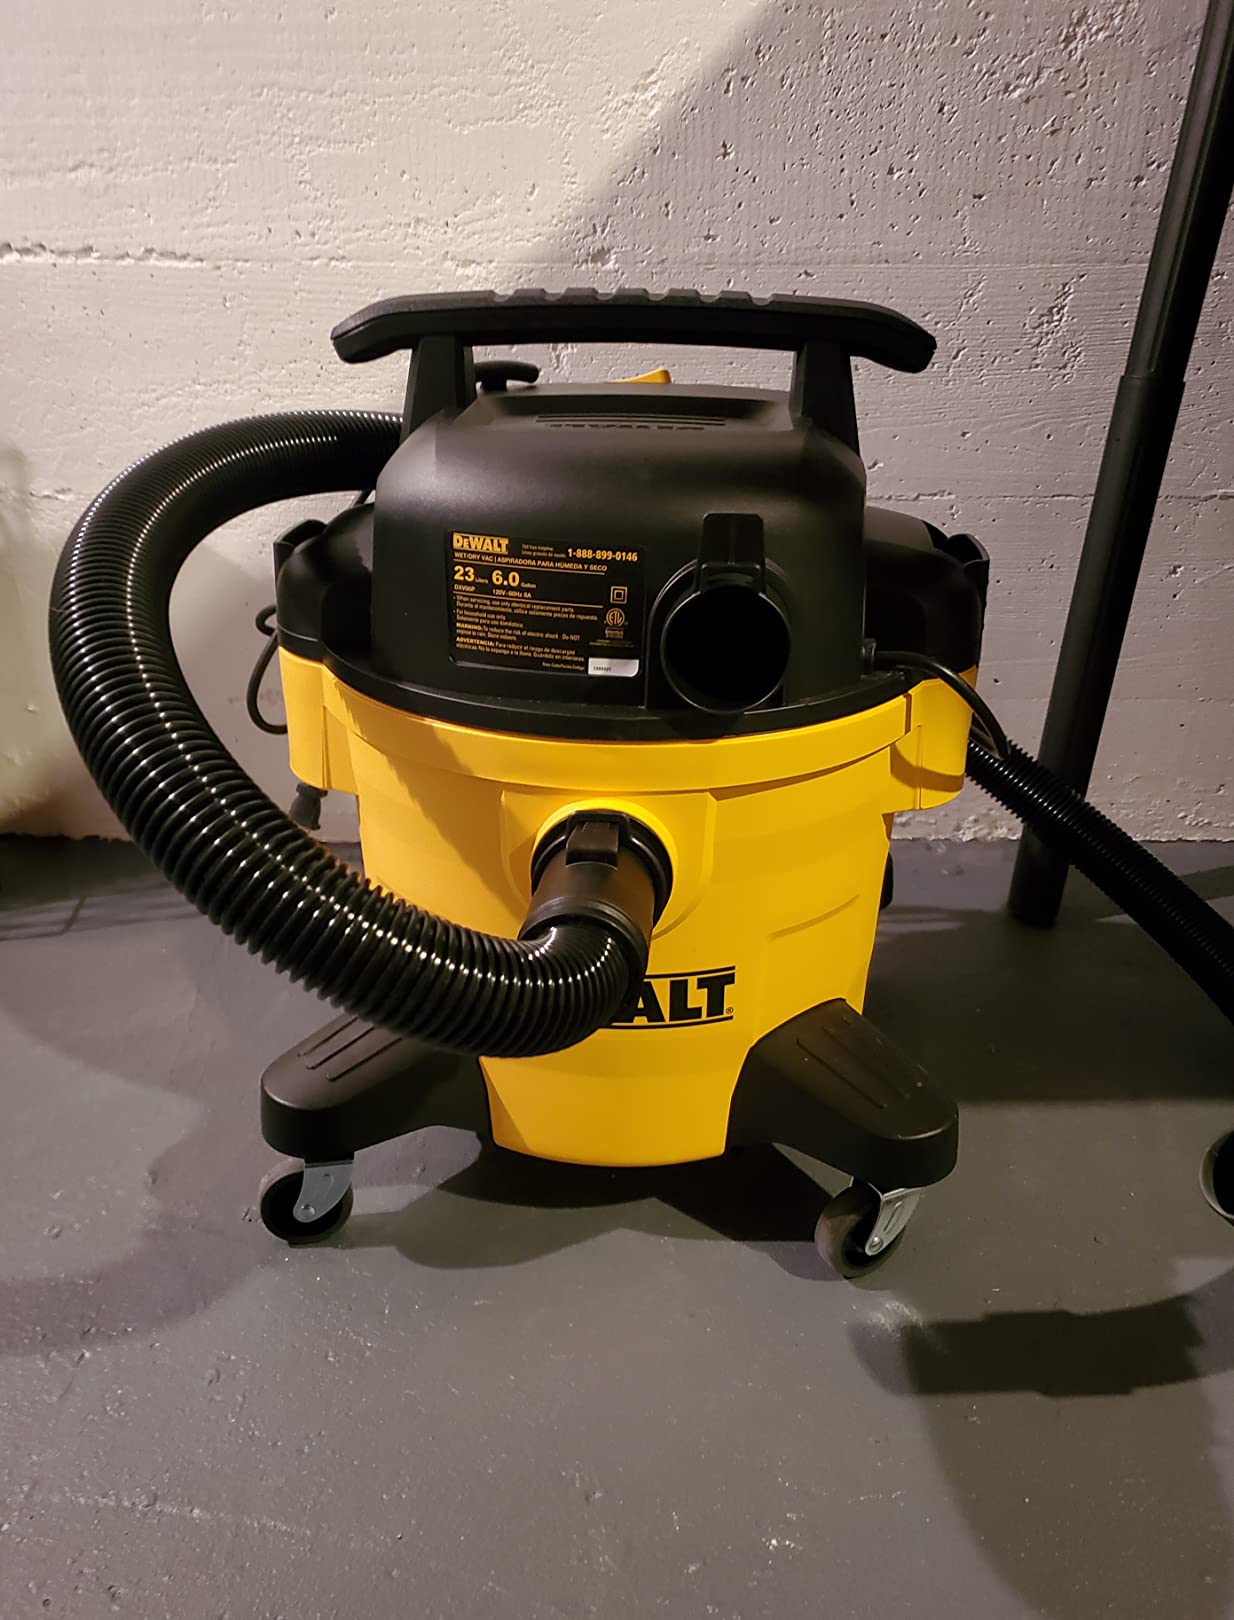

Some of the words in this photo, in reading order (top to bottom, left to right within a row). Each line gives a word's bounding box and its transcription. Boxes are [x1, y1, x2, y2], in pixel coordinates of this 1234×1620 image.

[454, 552, 480, 560] WET/DRY
[497, 556, 536, 566] ASPIRADORA
[568, 548, 638, 562] 1-888-899-0146
[454, 566, 475, 582] 23
[492, 570, 520, 587] 6.0
[612, 970, 736, 1024] ALT
